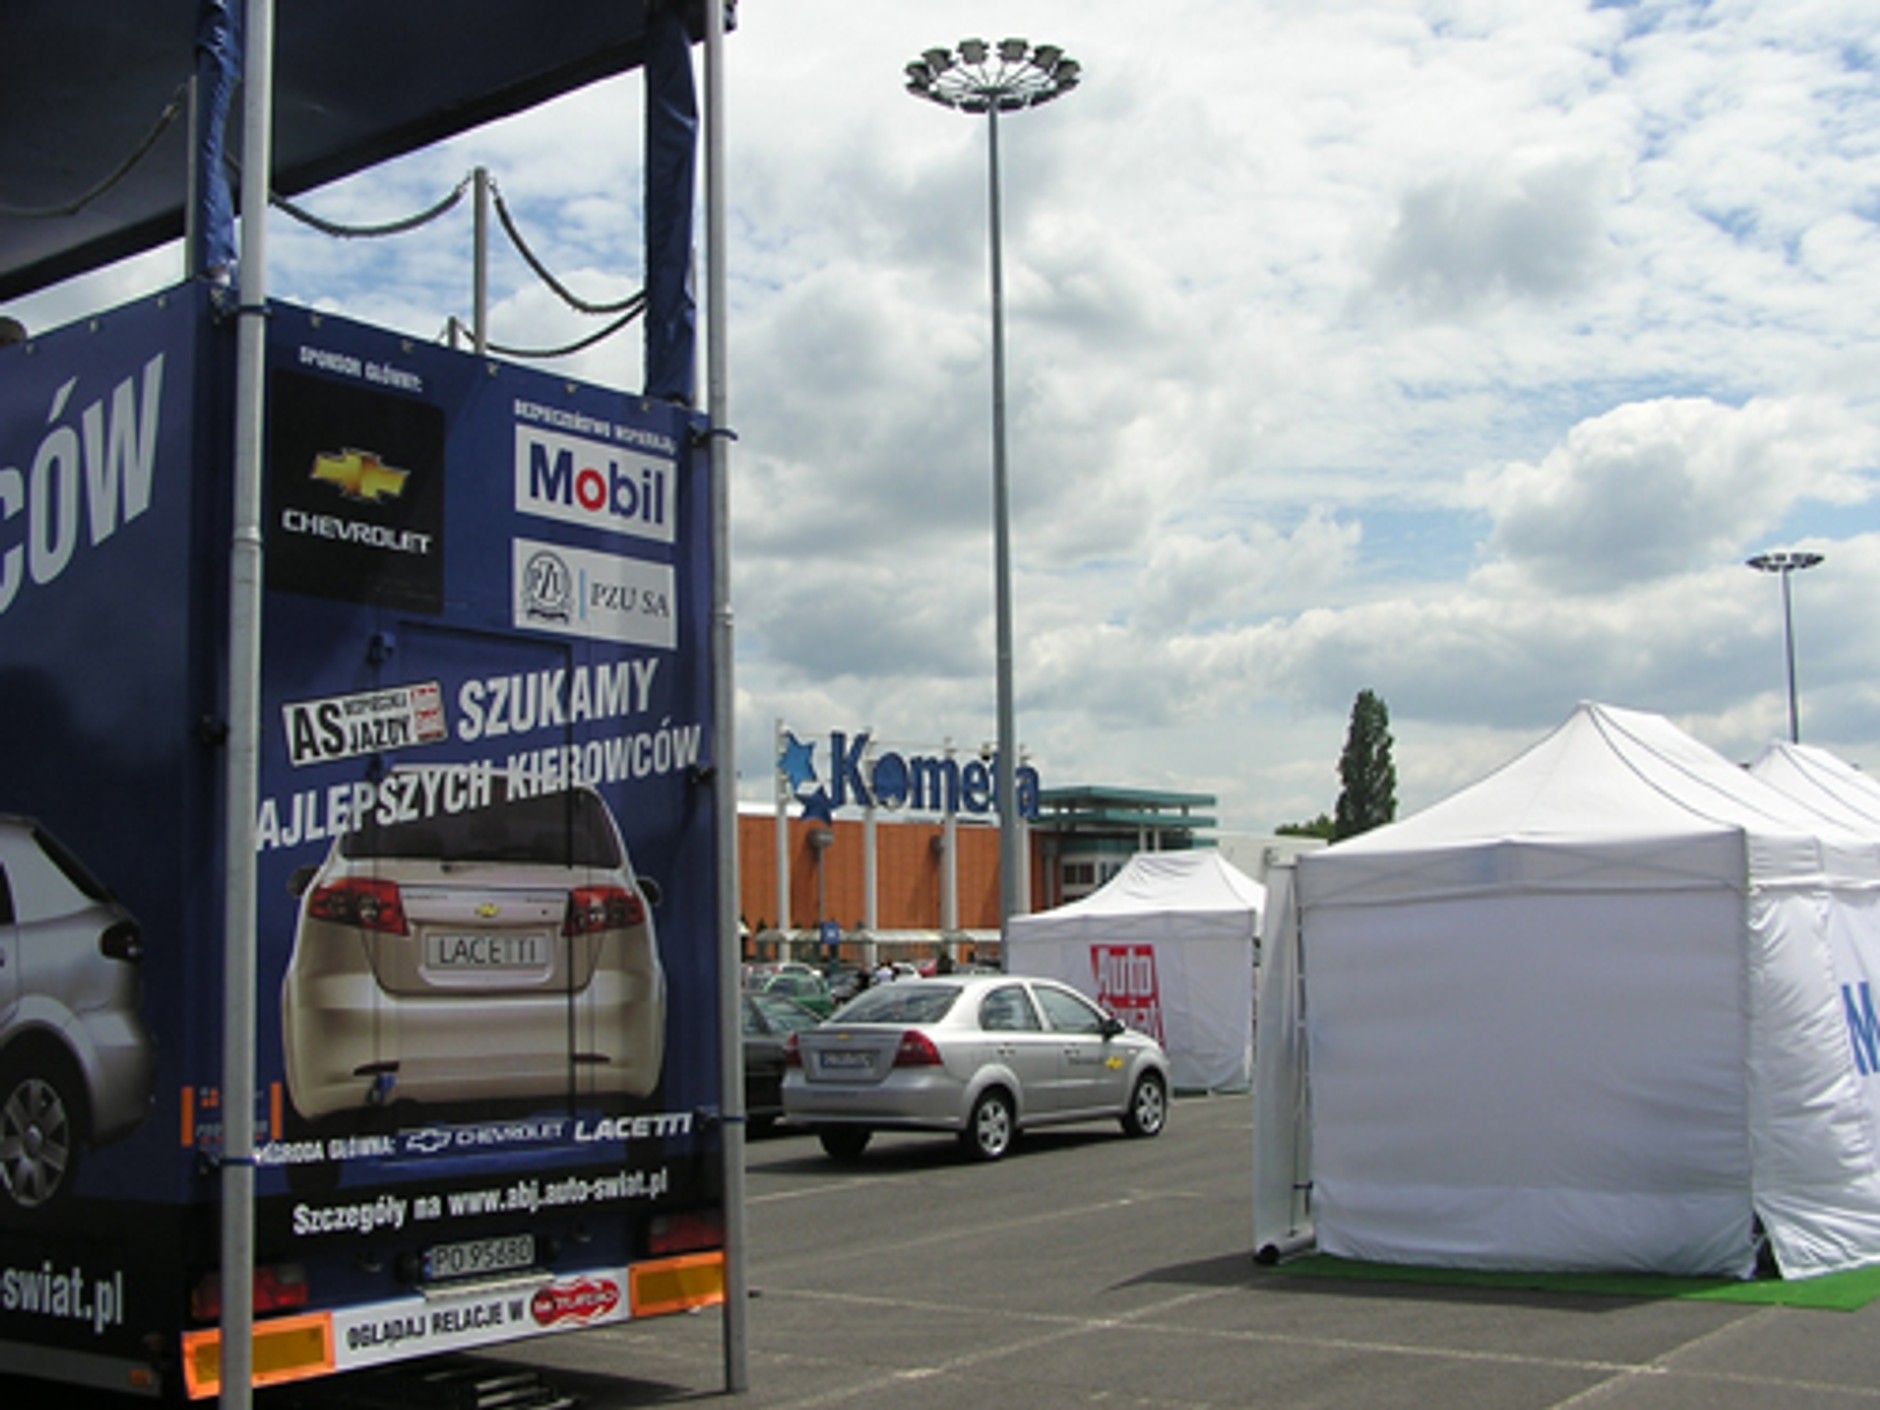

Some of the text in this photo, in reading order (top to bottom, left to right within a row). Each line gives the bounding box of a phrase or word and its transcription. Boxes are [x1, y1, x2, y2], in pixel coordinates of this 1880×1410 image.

[530, 441, 663, 525] Mobil
[282, 508, 433, 554] CHEVROLET
[590, 582, 671, 619] PZU SA
[457, 657, 659, 743] SZUKAMY
[293, 703, 344, 760] AS
[350, 716, 411, 751] JAZDY
[255, 715, 701, 852] AJLEPSZYCH KIEROWCÓW
[440, 938, 536, 965] LACETTI
[575, 1113, 693, 1141] LACETTI
[293, 1167, 668, 1235] Szczegóły na www.abj.auto-swiat.pl
[347, 1316, 426, 1350] OGLĄDAJ
[432, 1300, 504, 1335] RELACJE
[508, 1298, 525, 1322] W
